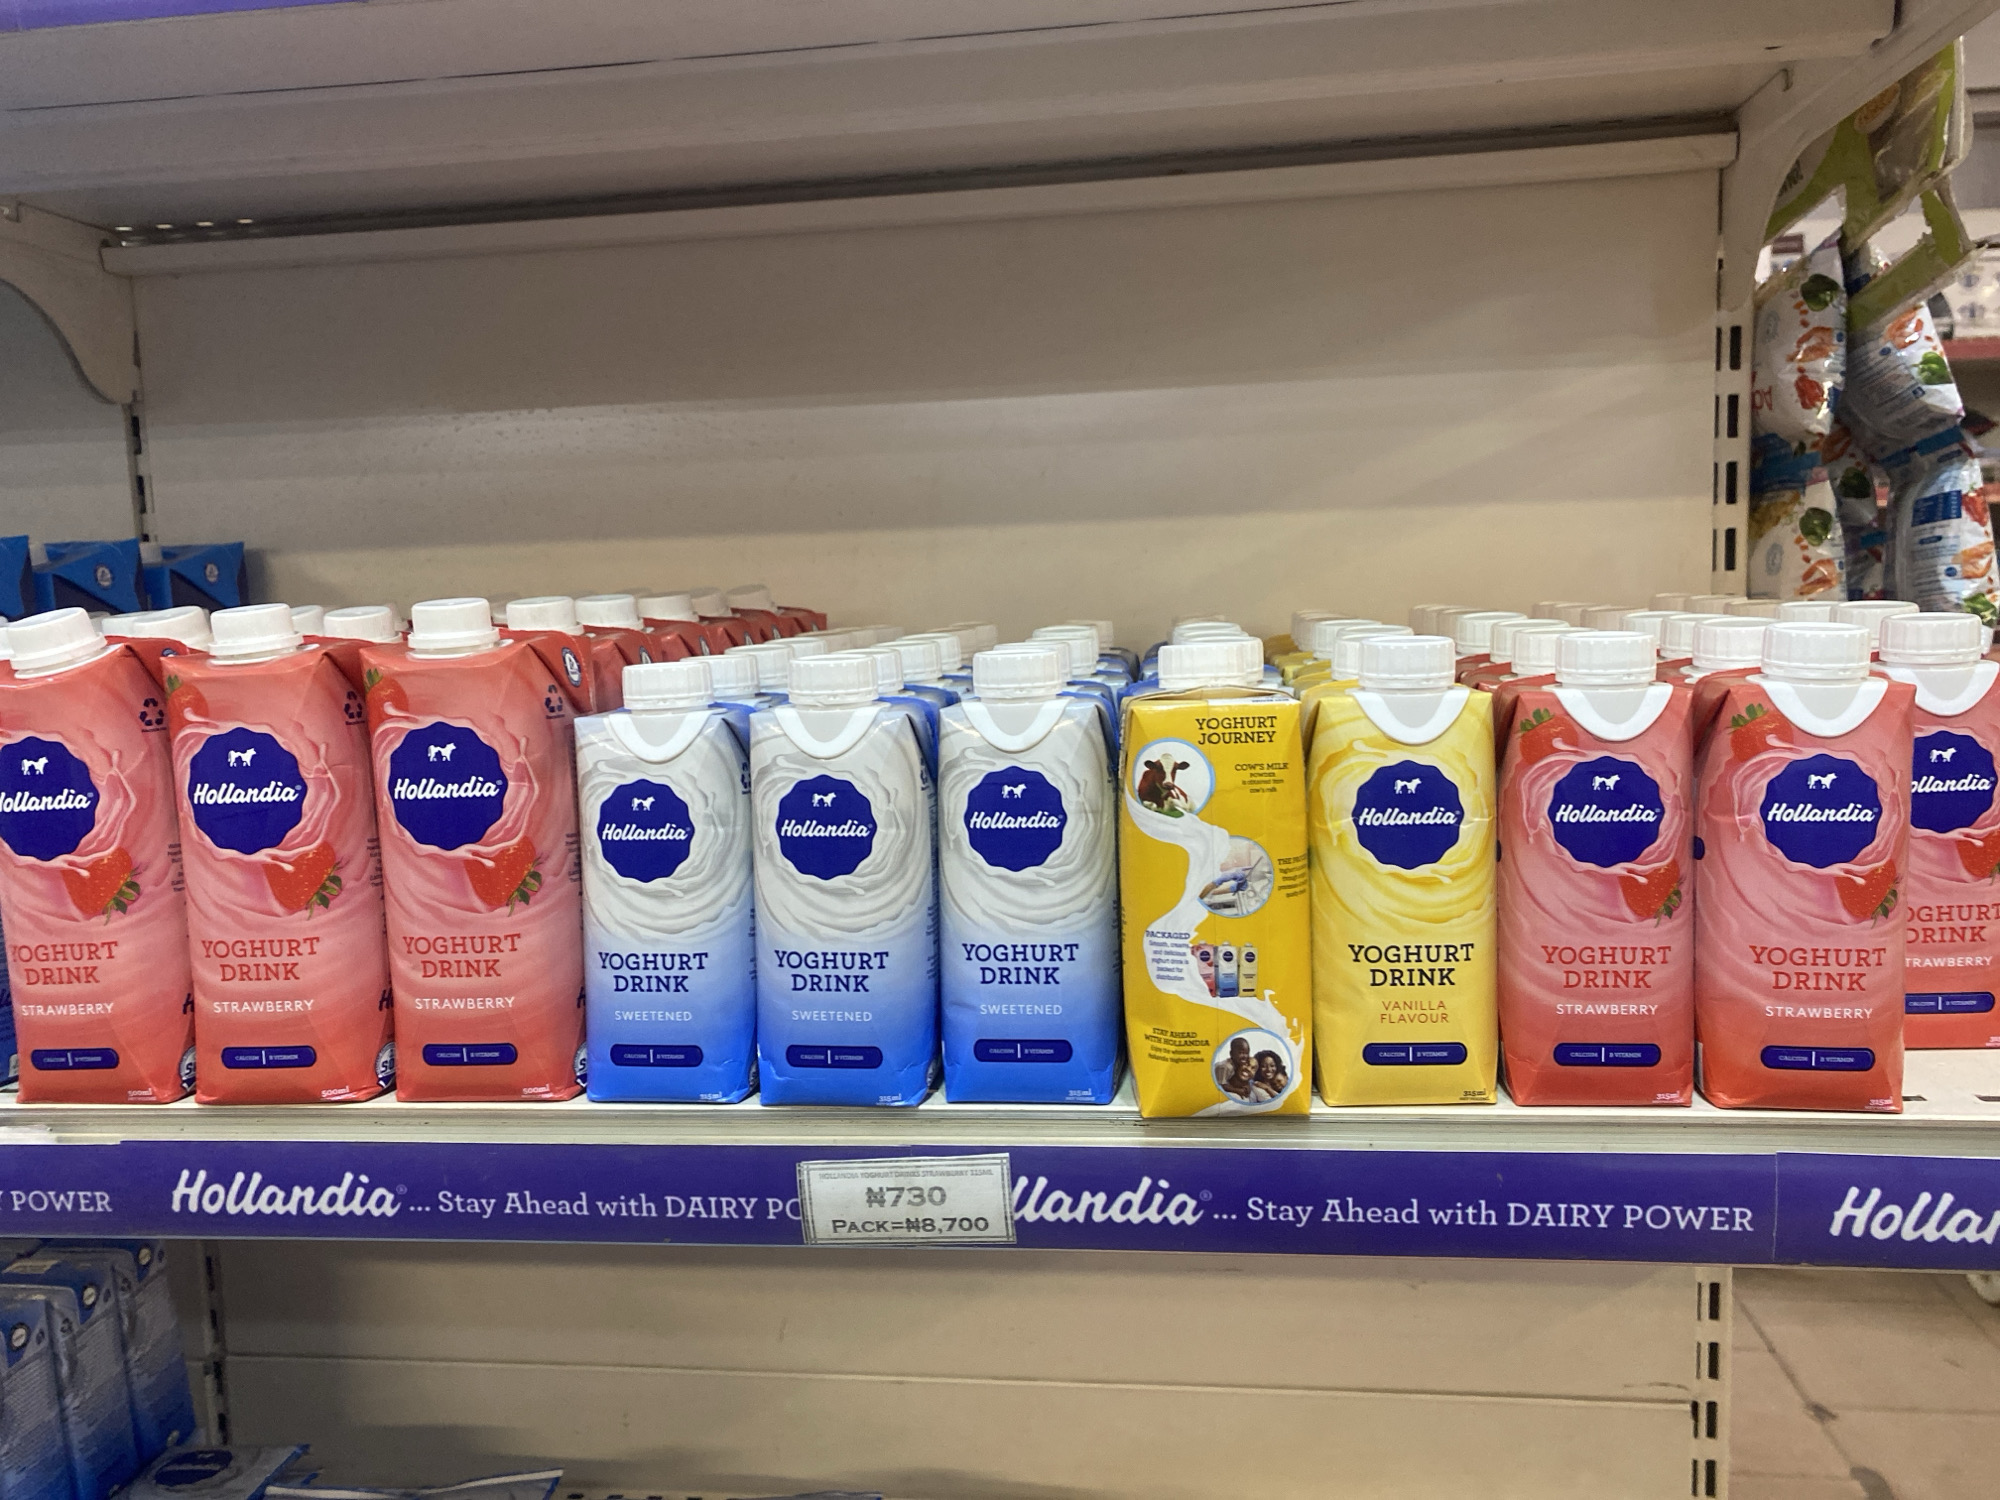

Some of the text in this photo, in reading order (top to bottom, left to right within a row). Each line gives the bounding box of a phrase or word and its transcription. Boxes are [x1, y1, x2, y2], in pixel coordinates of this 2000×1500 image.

[1195, 716, 1277, 730] YOGHURT
[1198, 731, 1276, 745] JOURNEY
[1234, 763, 1265, 771] COW'S
[194, 781, 300, 805] Hollandia
[394, 777, 500, 801] Hollandia
[1911, 773, 1993, 793] ollandia
[969, 809, 1061, 830] Hollandia
[1358, 807, 1458, 827] Hollandia
[1555, 803, 1658, 824] Hollandia
[1767, 802, 1876, 824] Hollandia
[601, 821, 688, 842] Hollandia
[780, 818, 871, 838] Hollandia
[1907, 903, 2000, 922] OGHURT
[403, 933, 522, 955] YOGHURT
[1146, 931, 1190, 939] PACKAGED
[1906, 926, 1986, 943] DRINK
[201, 936, 320, 958] YOGHURT
[961, 943, 1079, 963] YOGHURT
[1348, 943, 1474, 963] YOGHURT
[1541, 945, 1672, 965] YOGHURT
[1749, 945, 1887, 967] YOGHURT
[421, 958, 503, 980] DRINK
[598, 951, 709, 971] YOGHURT
[775, 950, 889, 970] YOGHURT
[1905, 956, 1992, 967] TRAWBERRY
[25, 966, 100, 985] DRINK
[220, 962, 300, 982] DRINK
[979, 965, 1060, 986] DRINK
[1370, 968, 1456, 987] DRINK
[1562, 969, 1652, 989] DRINK
[1772, 971, 1866, 992] DRINK
[613, 973, 690, 993] DRINK
[791, 973, 871, 993] DRINK
[22, 1003, 114, 1016] STRAWBERRY
[213, 998, 314, 1014] STRAWBERRY
[415, 996, 515, 1011] STRAWBERRY
[979, 1003, 1062, 1017] SWEETENED
[1381, 1000, 1447, 1011] VANILLA
[1556, 1004, 1658, 1016] STRAWBERRY
[1765, 1005, 1873, 1020] STRAWBERRY
[614, 1010, 692, 1022] SWEETENED
[791, 1010, 872, 1023] SWEETENED
[1380, 1012, 1449, 1024] FLAVOUR
[127, 1088, 152, 1097] 500ml
[321, 1086, 350, 1098] 500ml
[523, 1084, 550, 1095] 500ml
[12, 1190, 113, 1212] POWER
[172, 1169, 401, 1217] Hollandia
[438, 1190, 496, 1218] Stay
[504, 1191, 589, 1216] Ahead
[595, 1193, 657, 1217] with
[665, 1196, 757, 1219] DAIRY
[1013, 1175, 1202, 1225] llandia
[1247, 1197, 1314, 1228] Stay
[1321, 1199, 1419, 1224] Ahead
[1428, 1200, 1498, 1226] with
[1507, 1203, 1612, 1228] DAIRY
[1622, 1204, 1754, 1232] POWER
[1829, 1186, 2000, 1244] Holla
